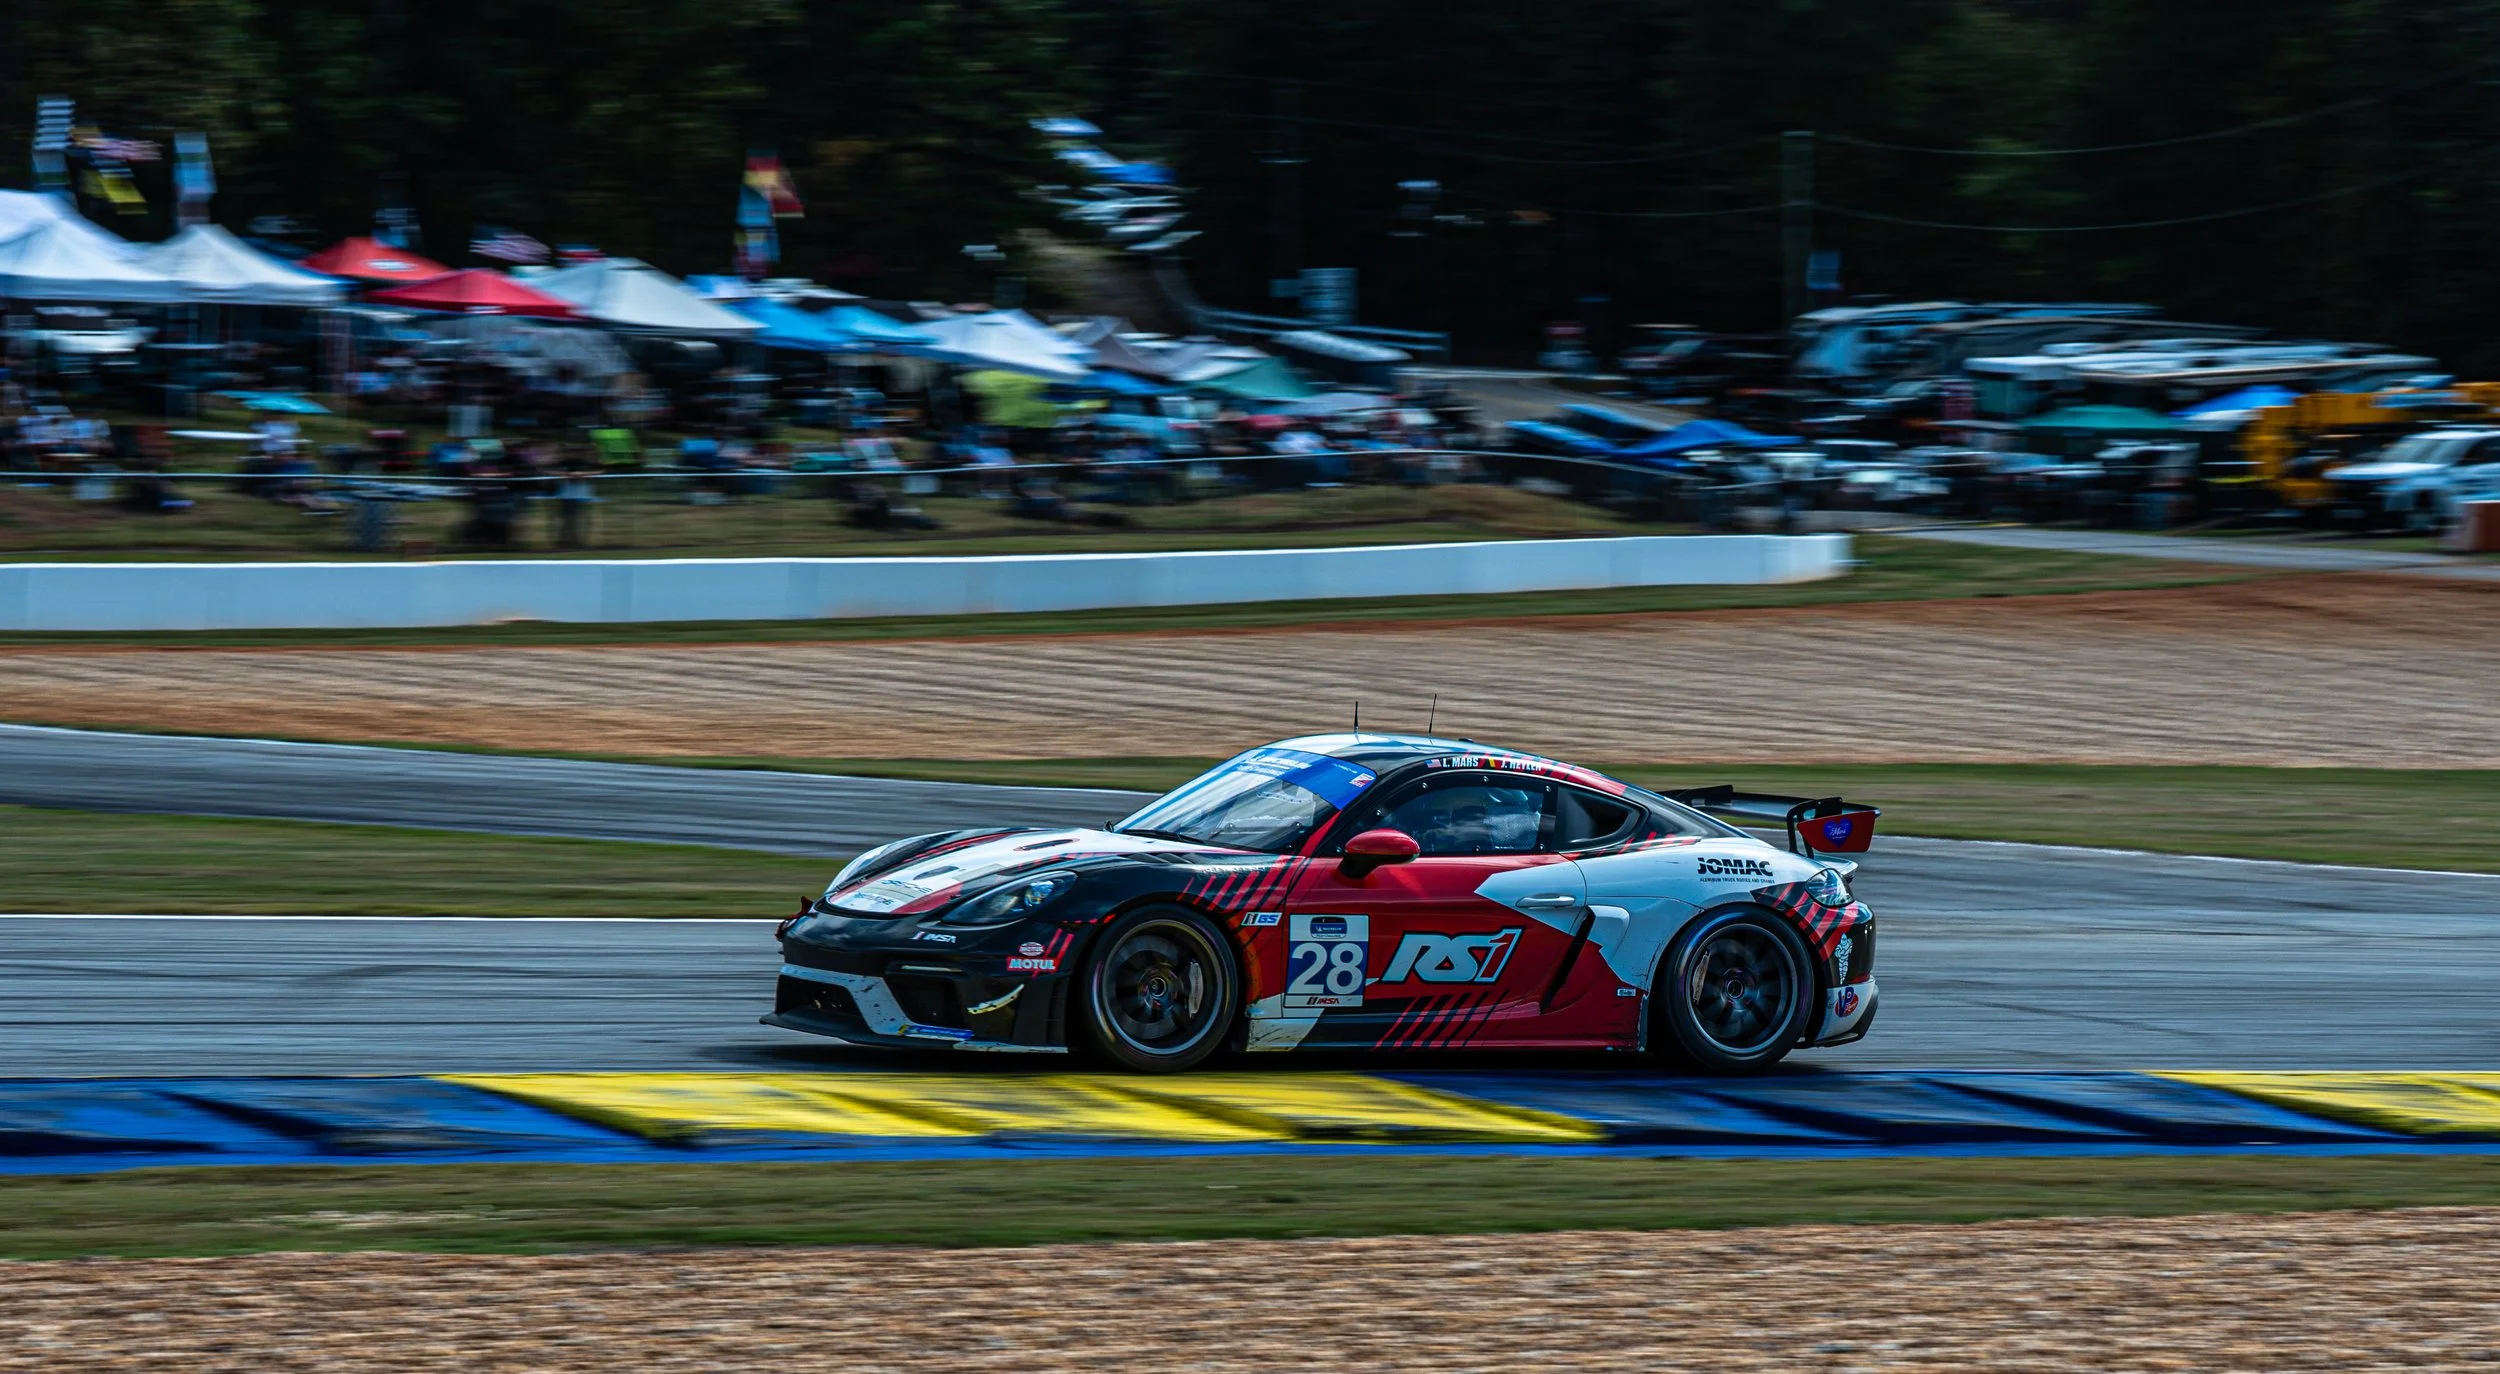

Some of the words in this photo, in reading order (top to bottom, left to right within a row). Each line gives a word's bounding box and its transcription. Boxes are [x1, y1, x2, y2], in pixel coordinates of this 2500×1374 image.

[1442, 759, 1450, 768] L.
[1451, 757, 1479, 768] MARS
[1501, 760, 1508, 769] J.
[1697, 857, 1774, 877] JOMAC
[1257, 914, 1279, 923] GS
[1009, 958, 1056, 970] MOTUL
[1287, 942, 1364, 995] 28
